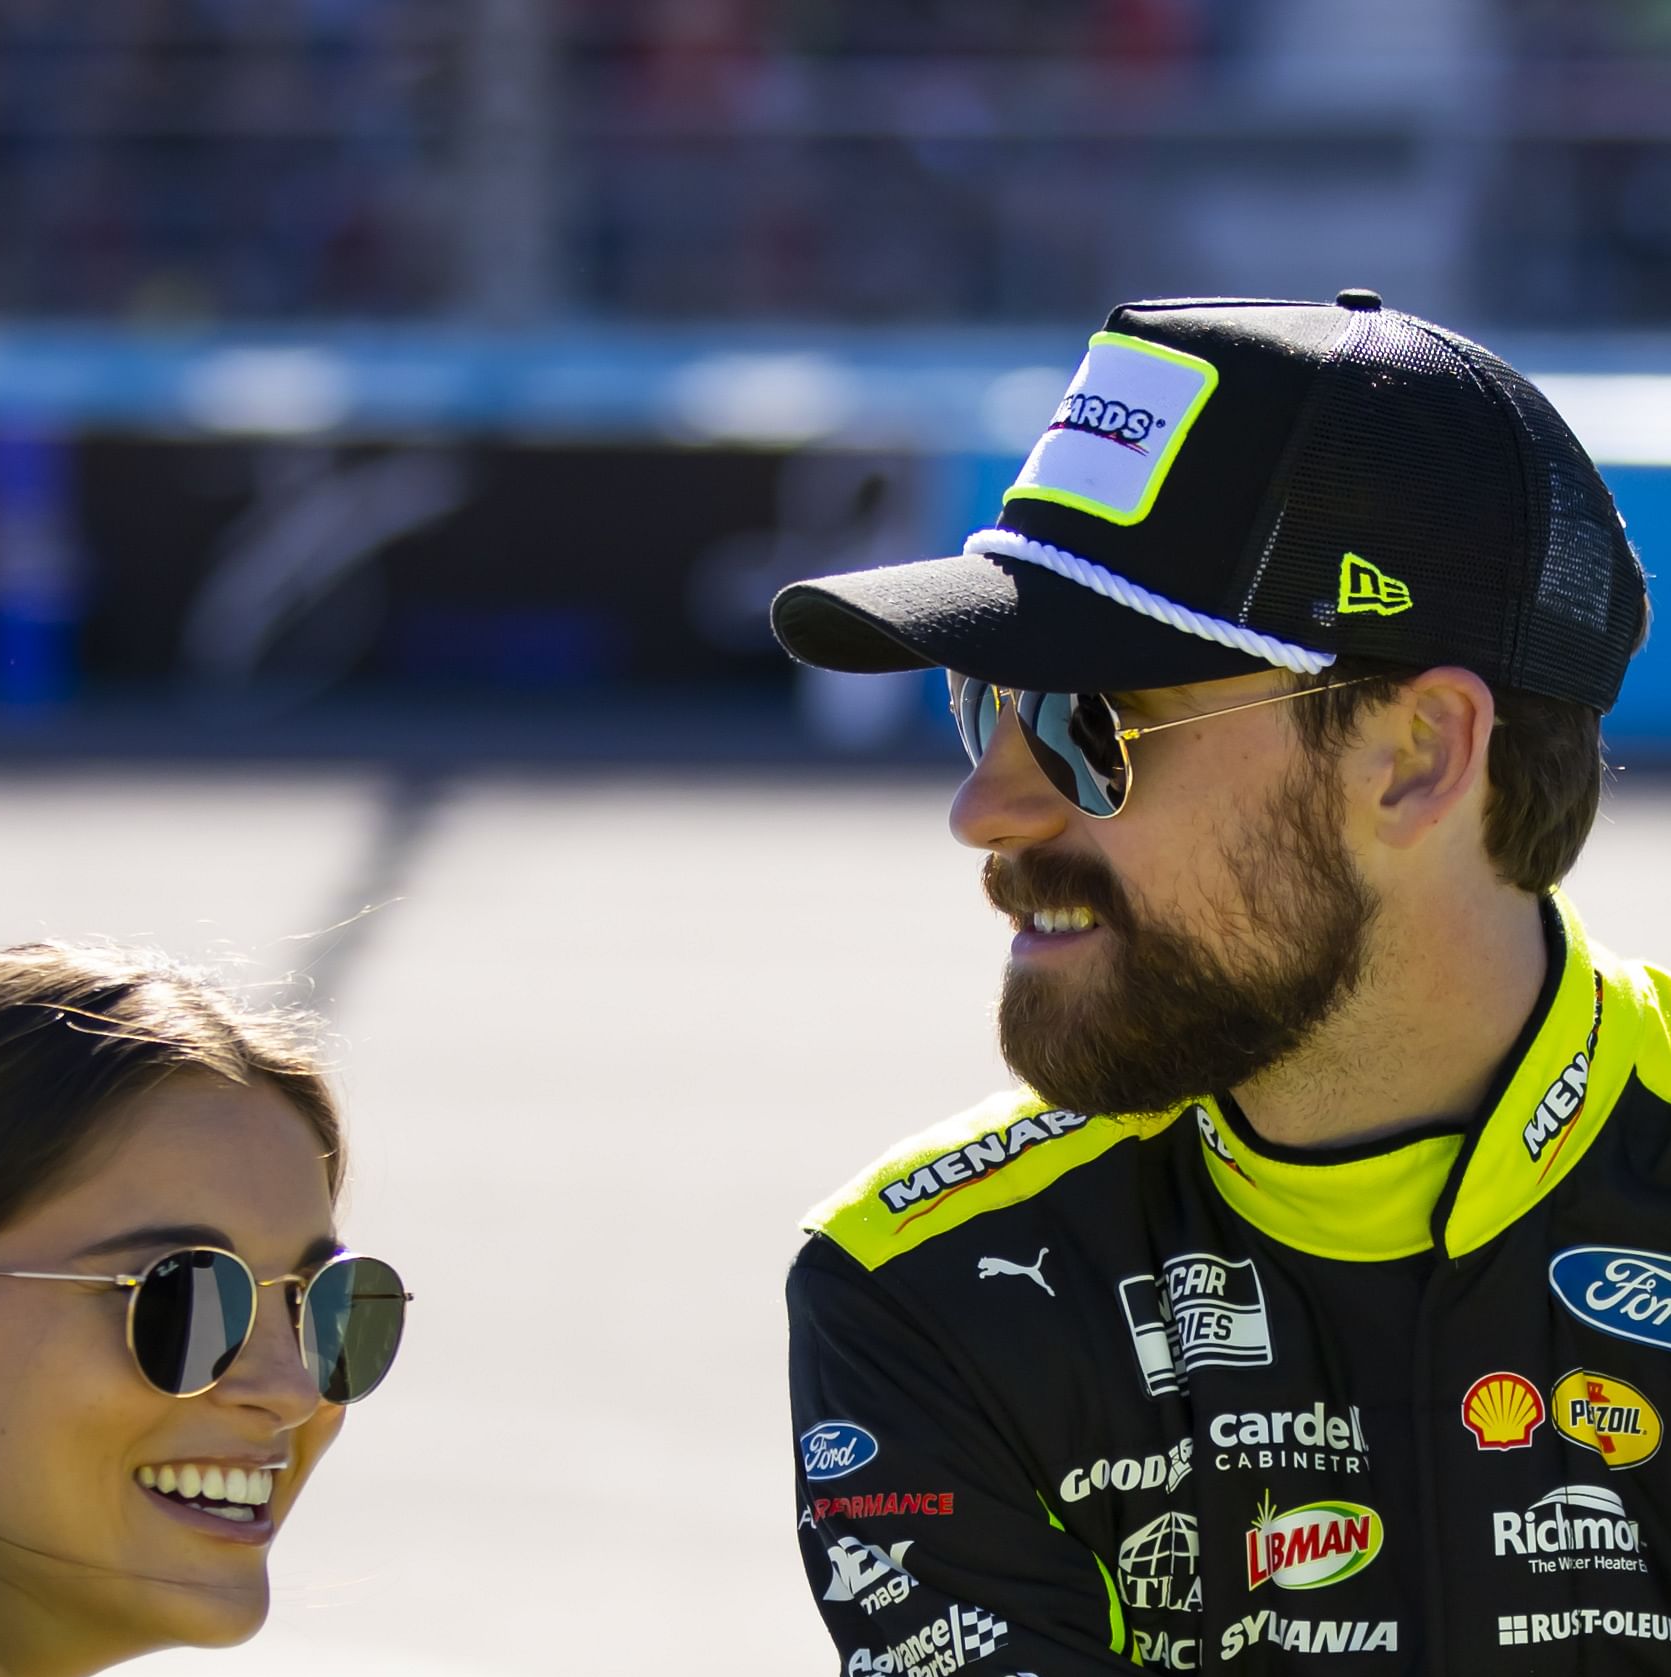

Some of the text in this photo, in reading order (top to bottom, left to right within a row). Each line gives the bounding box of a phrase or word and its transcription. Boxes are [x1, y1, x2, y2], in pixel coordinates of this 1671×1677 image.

[1166, 1263, 1227, 1301] CAR
[805, 1430, 858, 1472] Ford
[1528, 1558, 1556, 1575] The
[1594, 1555, 1638, 1573] Heater
